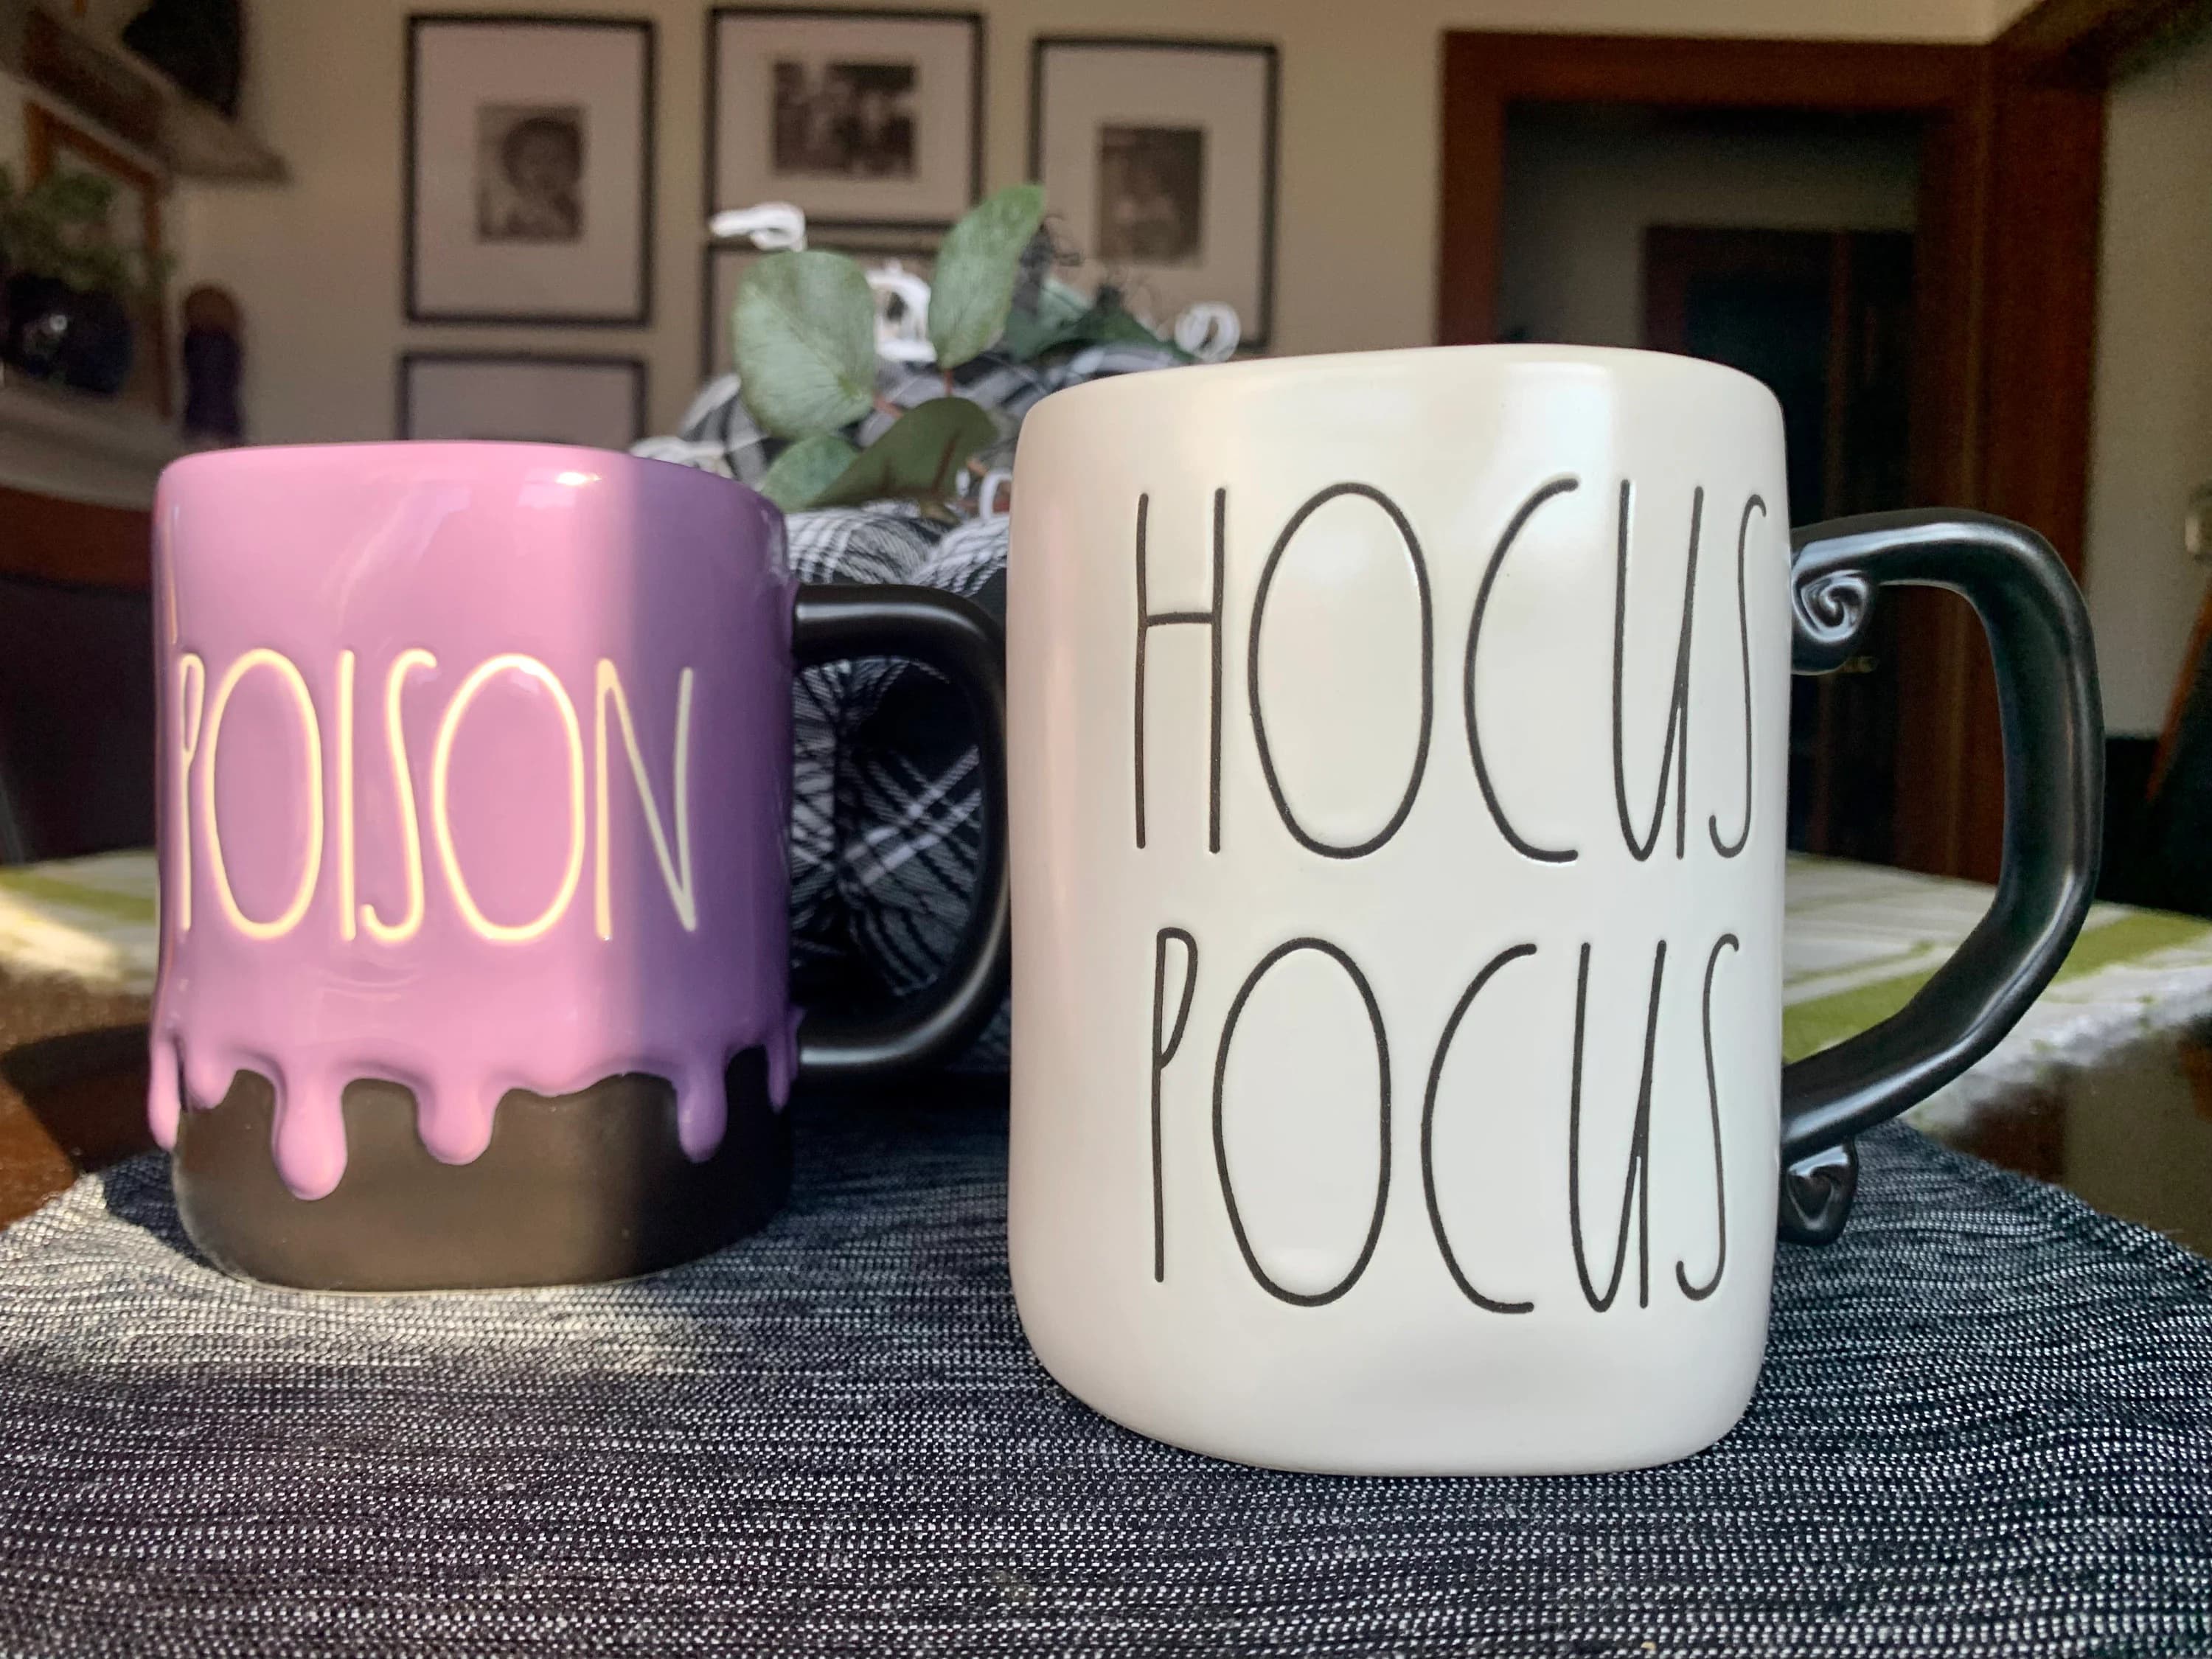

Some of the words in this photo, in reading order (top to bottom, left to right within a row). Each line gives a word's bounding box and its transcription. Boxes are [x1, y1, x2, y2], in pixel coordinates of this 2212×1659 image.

[177, 647, 697, 942] POISON
[1135, 477, 1767, 862] HOCUS
[1152, 927, 1739, 1315] POCUS
